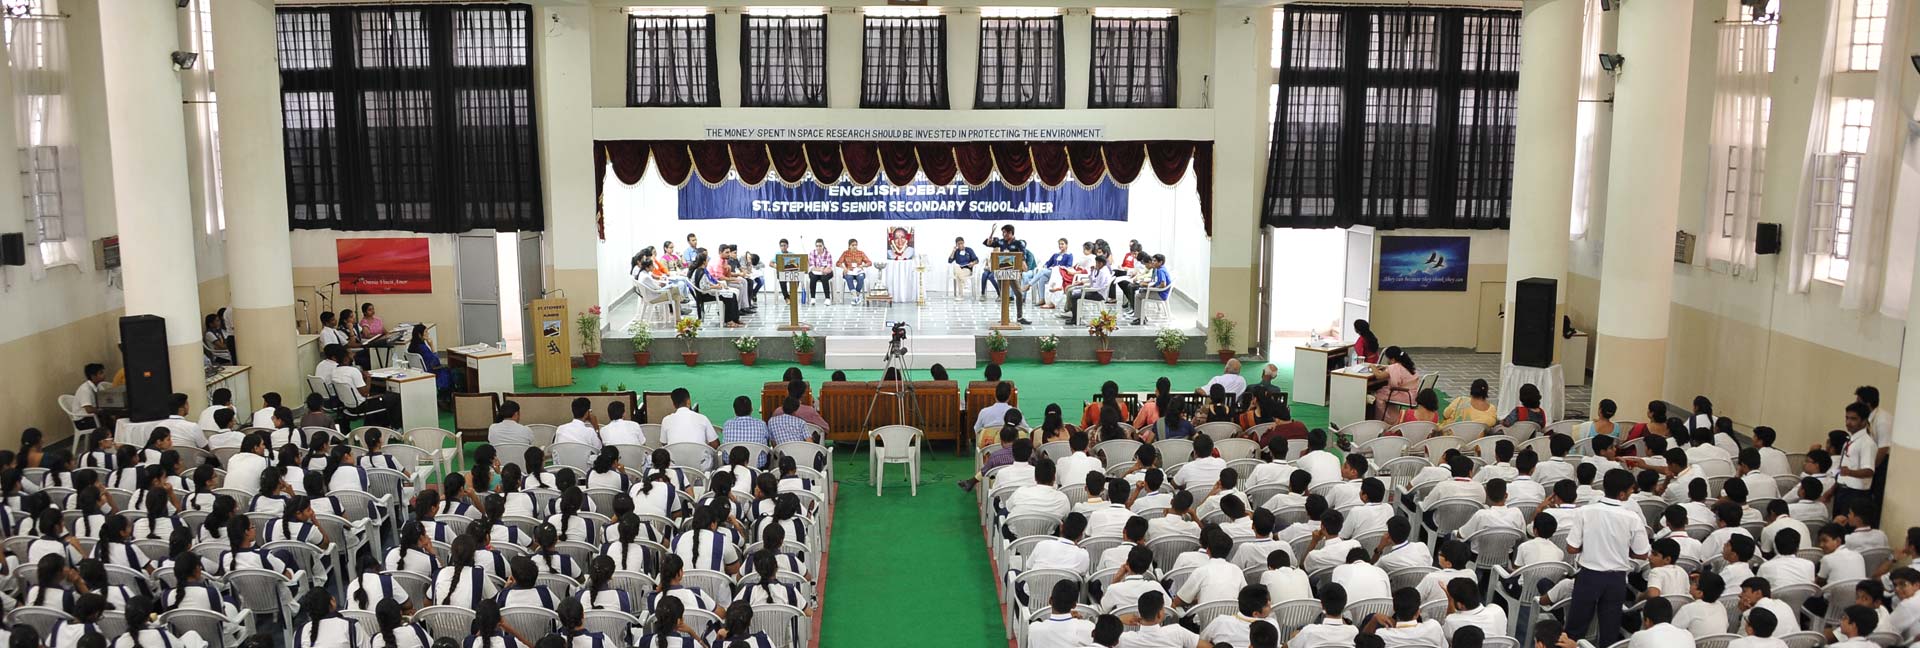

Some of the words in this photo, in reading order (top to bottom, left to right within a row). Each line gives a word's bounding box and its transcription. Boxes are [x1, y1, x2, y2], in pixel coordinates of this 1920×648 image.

[706, 128, 723, 138] THE
[724, 128, 755, 138] MONEY
[756, 128, 786, 138] SPENT
[787, 128, 796, 138] IN
[797, 128, 824, 138] SPACE
[826, 128, 871, 138] RESEARCH
[872, 128, 902, 138] SHOULD
[902, 129, 913, 138] BE
[915, 128, 957, 138] INVESTED
[958, 128, 967, 138] IN
[968, 128, 1021, 138] PROTECTING
[1022, 128, 1039, 138] THE
[1040, 128, 1104, 138] ENVIRONMENT.
[829, 185, 900, 196] ENGLISH
[905, 184, 969, 196] DEBATE
[841, 201, 887, 213] SENIOR
[888, 200, 967, 213] SECONDARY
[784, 271, 800, 281] FOR
